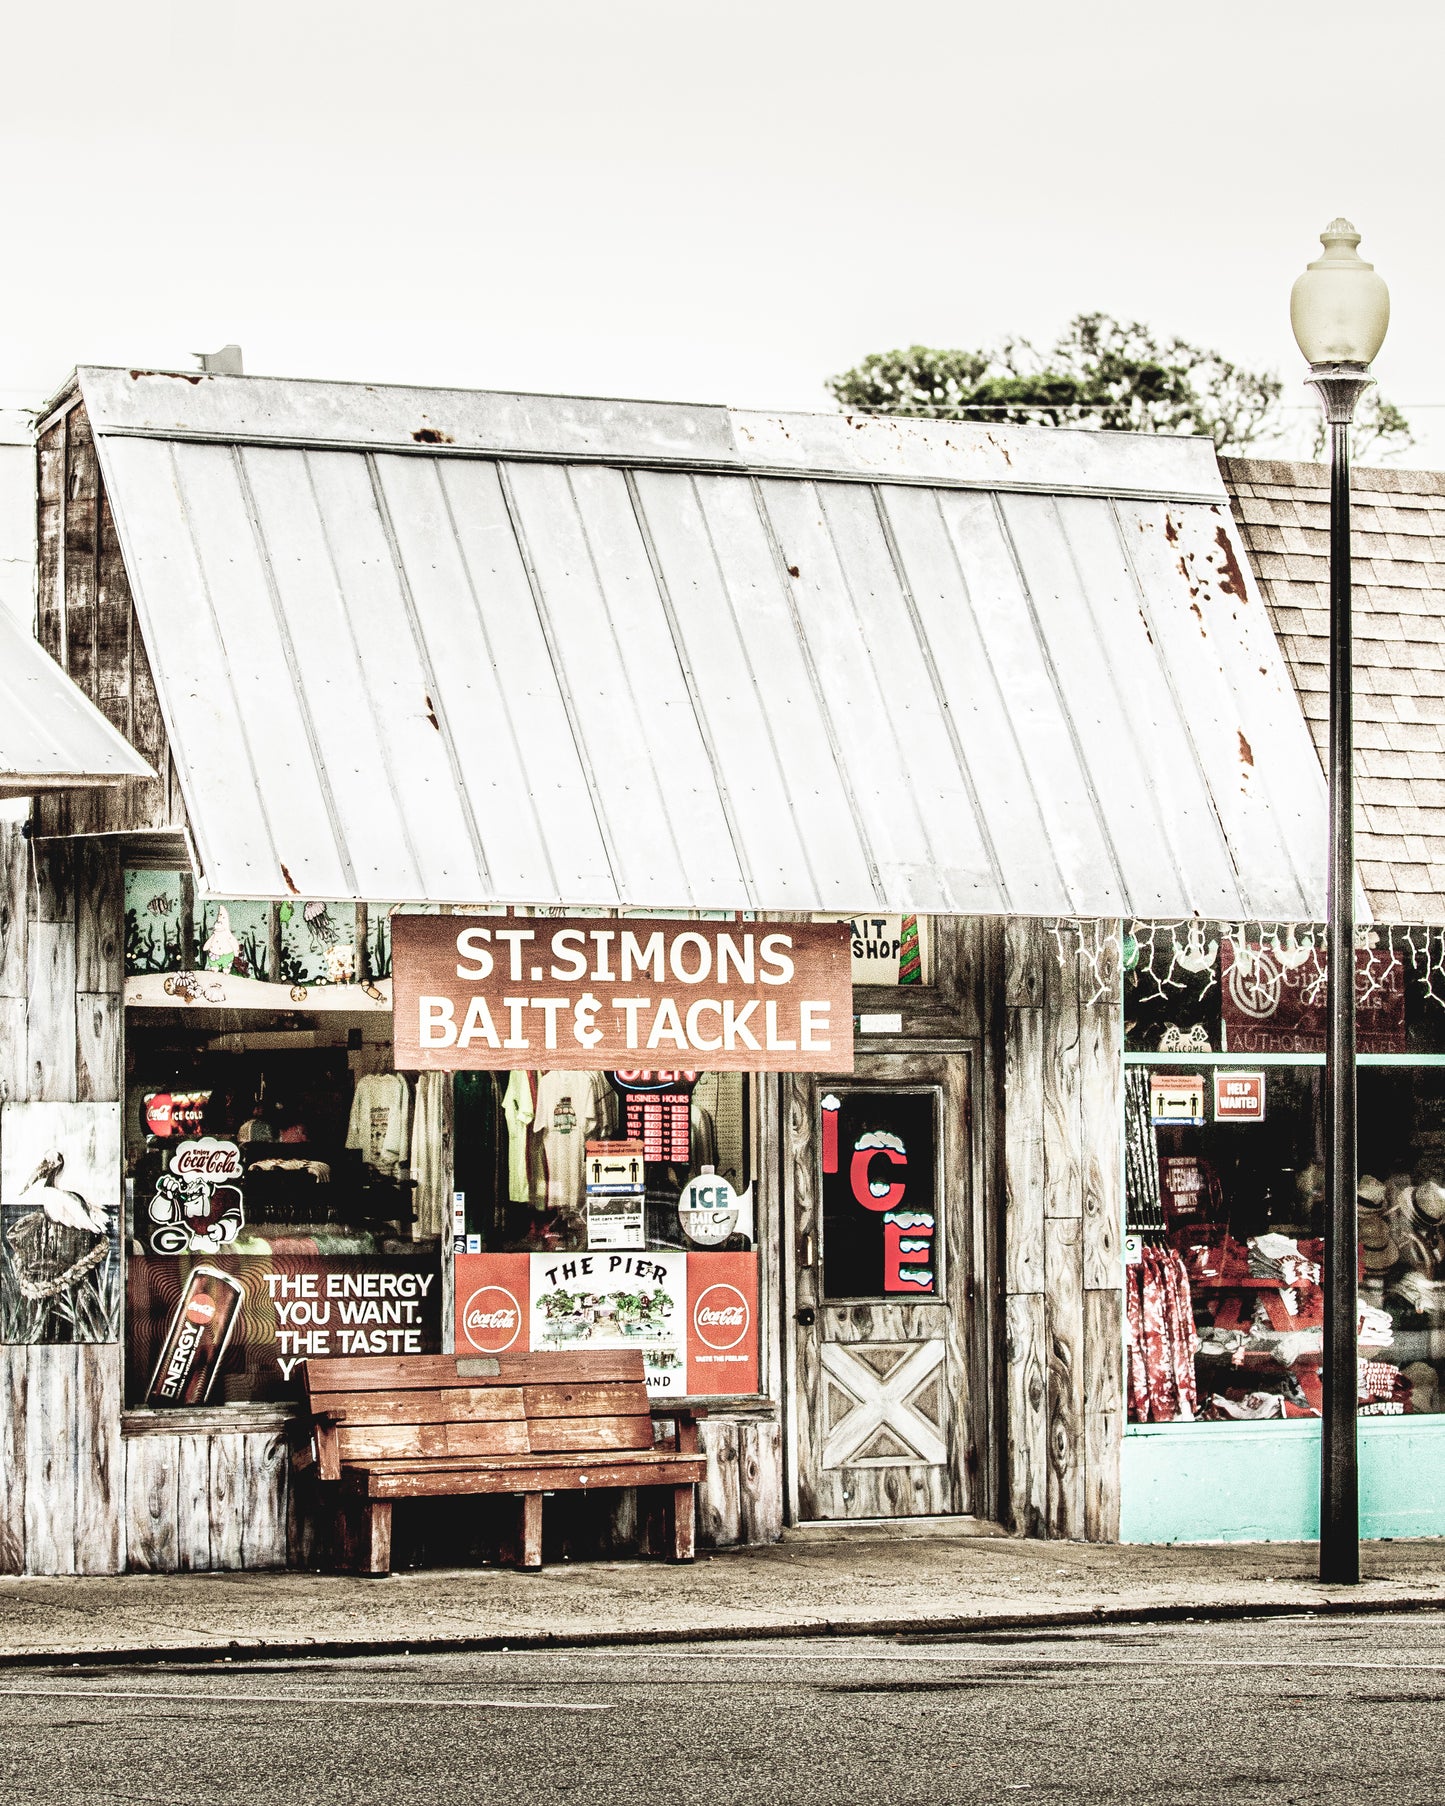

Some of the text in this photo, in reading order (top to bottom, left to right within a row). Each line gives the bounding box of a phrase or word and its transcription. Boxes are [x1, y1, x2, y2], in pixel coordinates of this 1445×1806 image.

[852, 939, 901, 959] SHOP
[612, 996, 831, 1051] TACKLE
[1167, 1045, 1204, 1053] WELCOME
[626, 1094, 689, 1104] BUSINESS HOURS
[1226, 1082, 1251, 1095] HELP
[1219, 1096, 1258, 1109] WANTED
[185, 1111, 203, 1120] COLD
[178, 1150, 238, 1174] Coca-Cola
[689, 1186, 728, 1209] ICE
[689, 1212, 714, 1225] BAIT
[1126, 1239, 1135, 1251] G
[545, 1255, 667, 1286] THE PIER
[263, 1274, 433, 1298] THE ENERGY
[274, 1300, 423, 1325] YOU WANT.
[275, 1329, 421, 1355] THE TASTE
[161, 1322, 198, 1398] ENERGY
